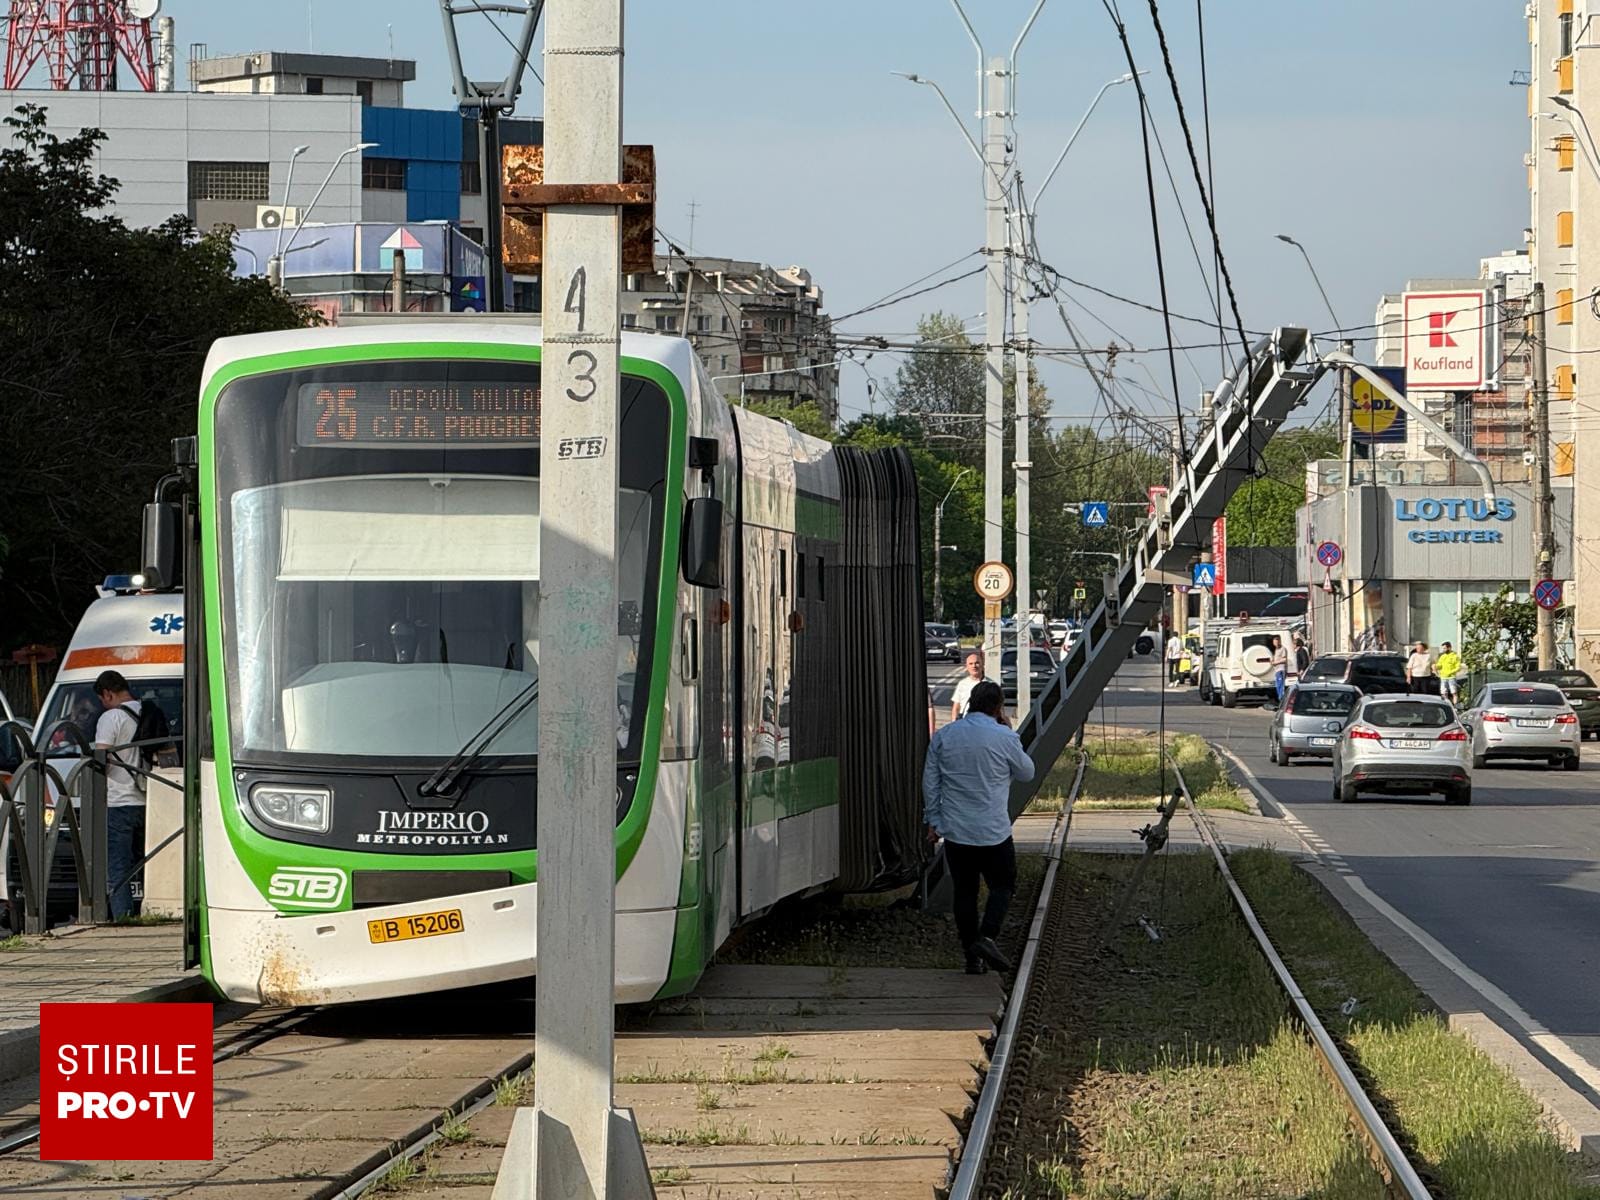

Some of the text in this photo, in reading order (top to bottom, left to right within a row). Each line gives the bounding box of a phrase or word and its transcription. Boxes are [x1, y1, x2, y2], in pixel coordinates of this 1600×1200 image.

[1413, 356, 1473, 370] Kaufland
[566, 349, 598, 402] 3
[390, 389, 464, 411] DEPOUL
[316, 389, 357, 440] 25
[373, 416, 435, 437] C.F.R.
[1395, 497, 1514, 521] LOTUS
[1408, 529, 1502, 543] CENTER
[984, 579, 1000, 590] 20
[376, 811, 489, 833] IMPERIO
[357, 834, 508, 845] METROPOLITAN
[268, 873, 339, 899] STB
[385, 912, 460, 938] B 15206
